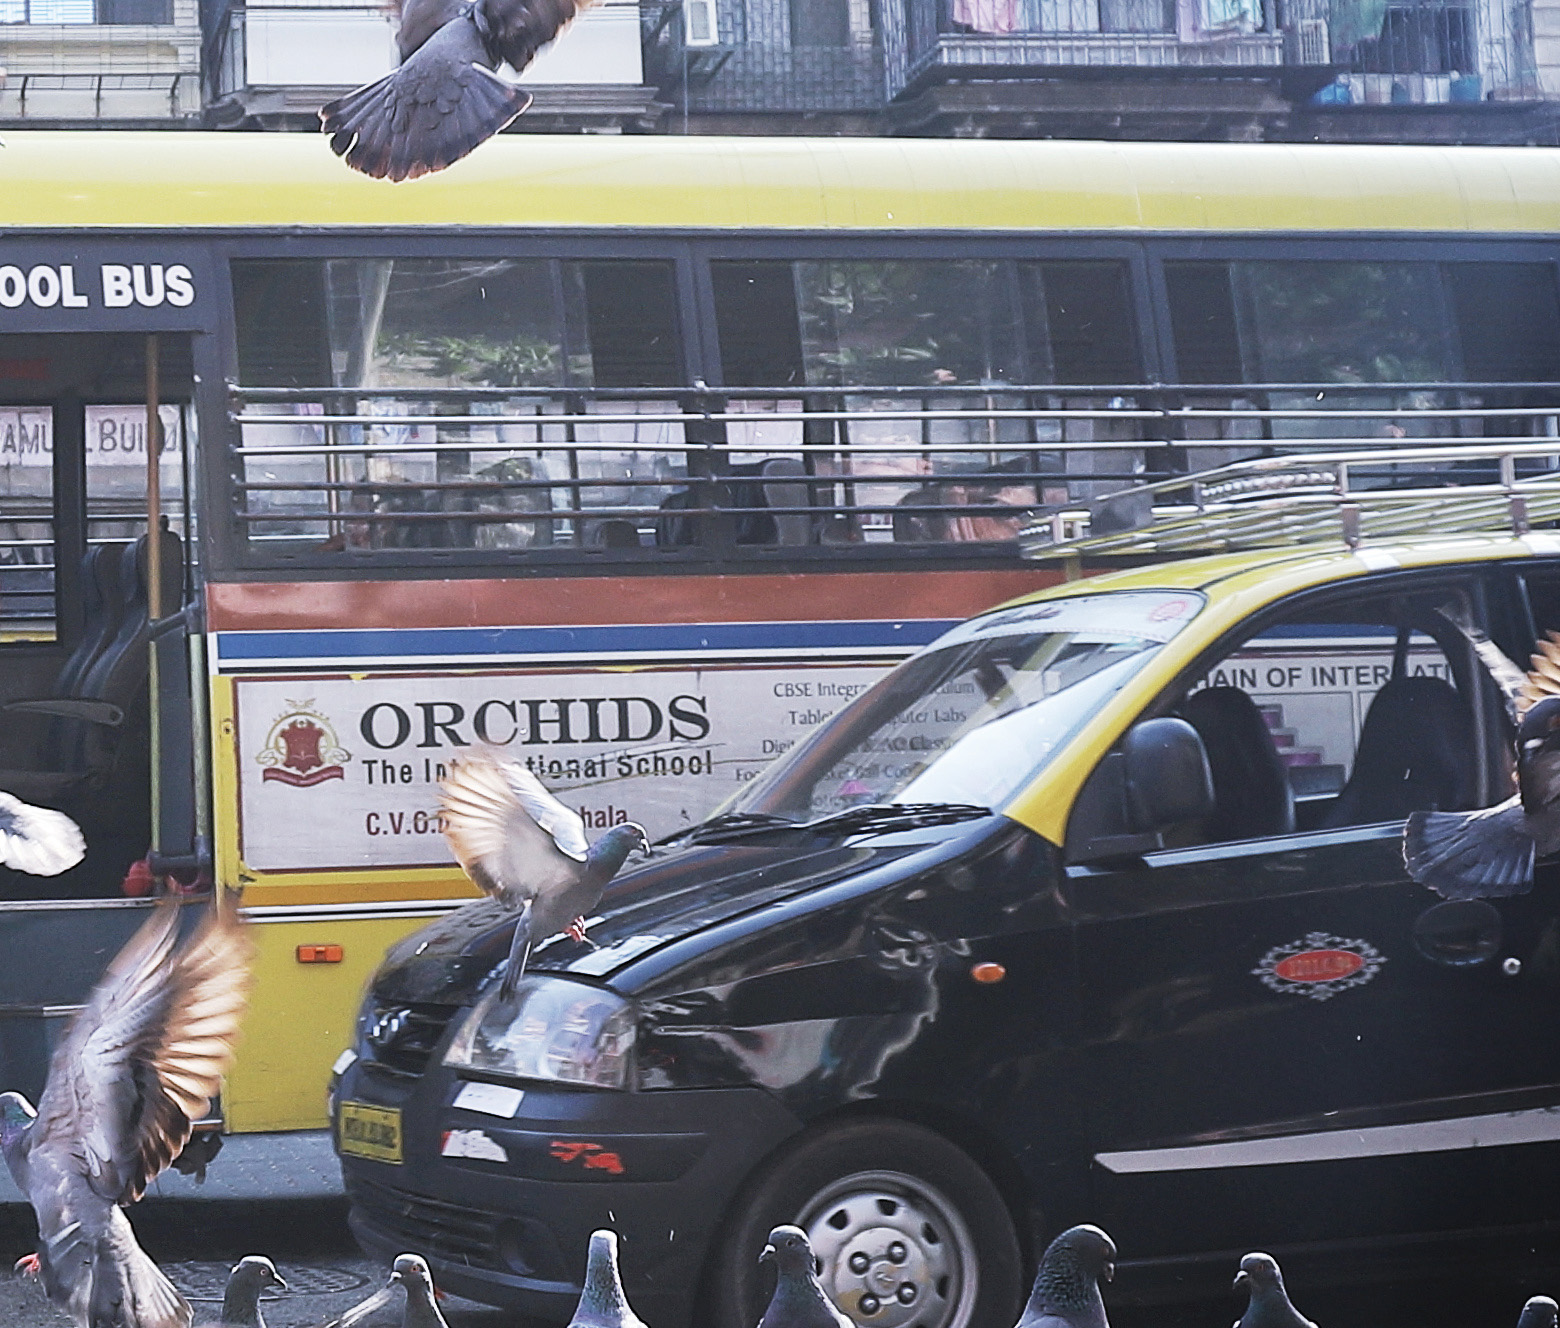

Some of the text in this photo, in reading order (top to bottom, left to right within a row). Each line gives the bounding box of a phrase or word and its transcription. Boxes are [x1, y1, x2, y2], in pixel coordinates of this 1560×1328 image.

[101, 264, 195, 309] BUS
[774, 682, 813, 698] CBSE
[1266, 666, 1300, 688] OF
[360, 695, 711, 750] ORCHIDS
[362, 759, 413, 785] The
[617, 750, 713, 778] School
